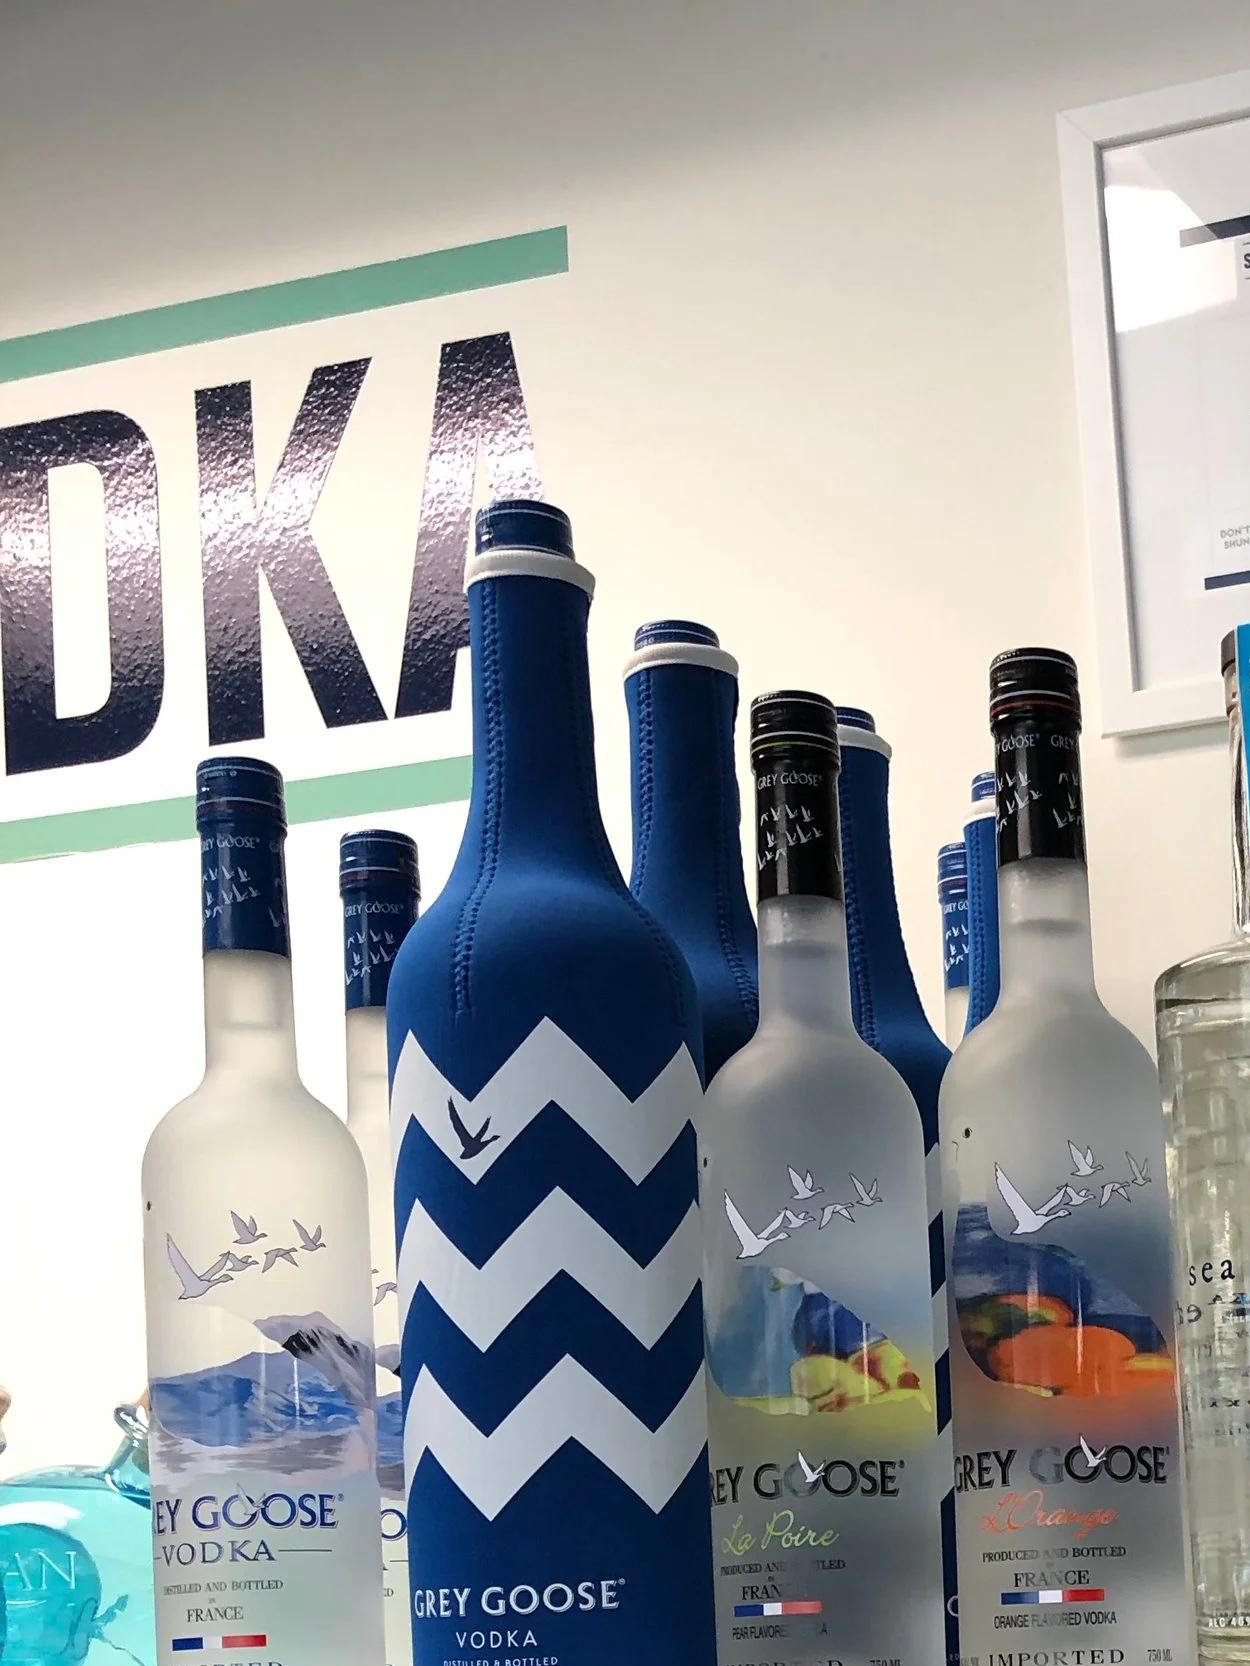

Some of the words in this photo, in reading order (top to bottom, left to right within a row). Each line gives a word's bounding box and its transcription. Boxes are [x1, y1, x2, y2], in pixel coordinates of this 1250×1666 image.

[1220, 526, 1250, 539] DON'T
[757, 774, 777, 790] GREY
[780, 771, 819, 787] GOOSE
[1188, 1260, 1236, 1286] sea
[954, 1450, 1017, 1493] GREY
[1029, 1445, 1167, 1485] GOOSE
[753, 1460, 900, 1499] GOOSE
[191, 1492, 339, 1532] GOOSE
[721, 1514, 756, 1556] La
[761, 1509, 839, 1550] Poire
[161, 1539, 276, 1566] VODKA
[982, 1550, 1039, 1563] PRODUCED
[1072, 1546, 1126, 1558] BOTTLED
[205, 1581, 227, 1593] AND
[231, 1579, 283, 1592] BOTTLED
[1014, 1570, 1090, 1588] FRANCE
[414, 1588, 471, 1618] GREY
[481, 1579, 620, 1615] GOOSE
[186, 1607, 243, 1623] FRANCE
[994, 1615, 1029, 1629] ORANGE
[1084, 1611, 1117, 1624] VODKA
[456, 1629, 538, 1649] VODKA
